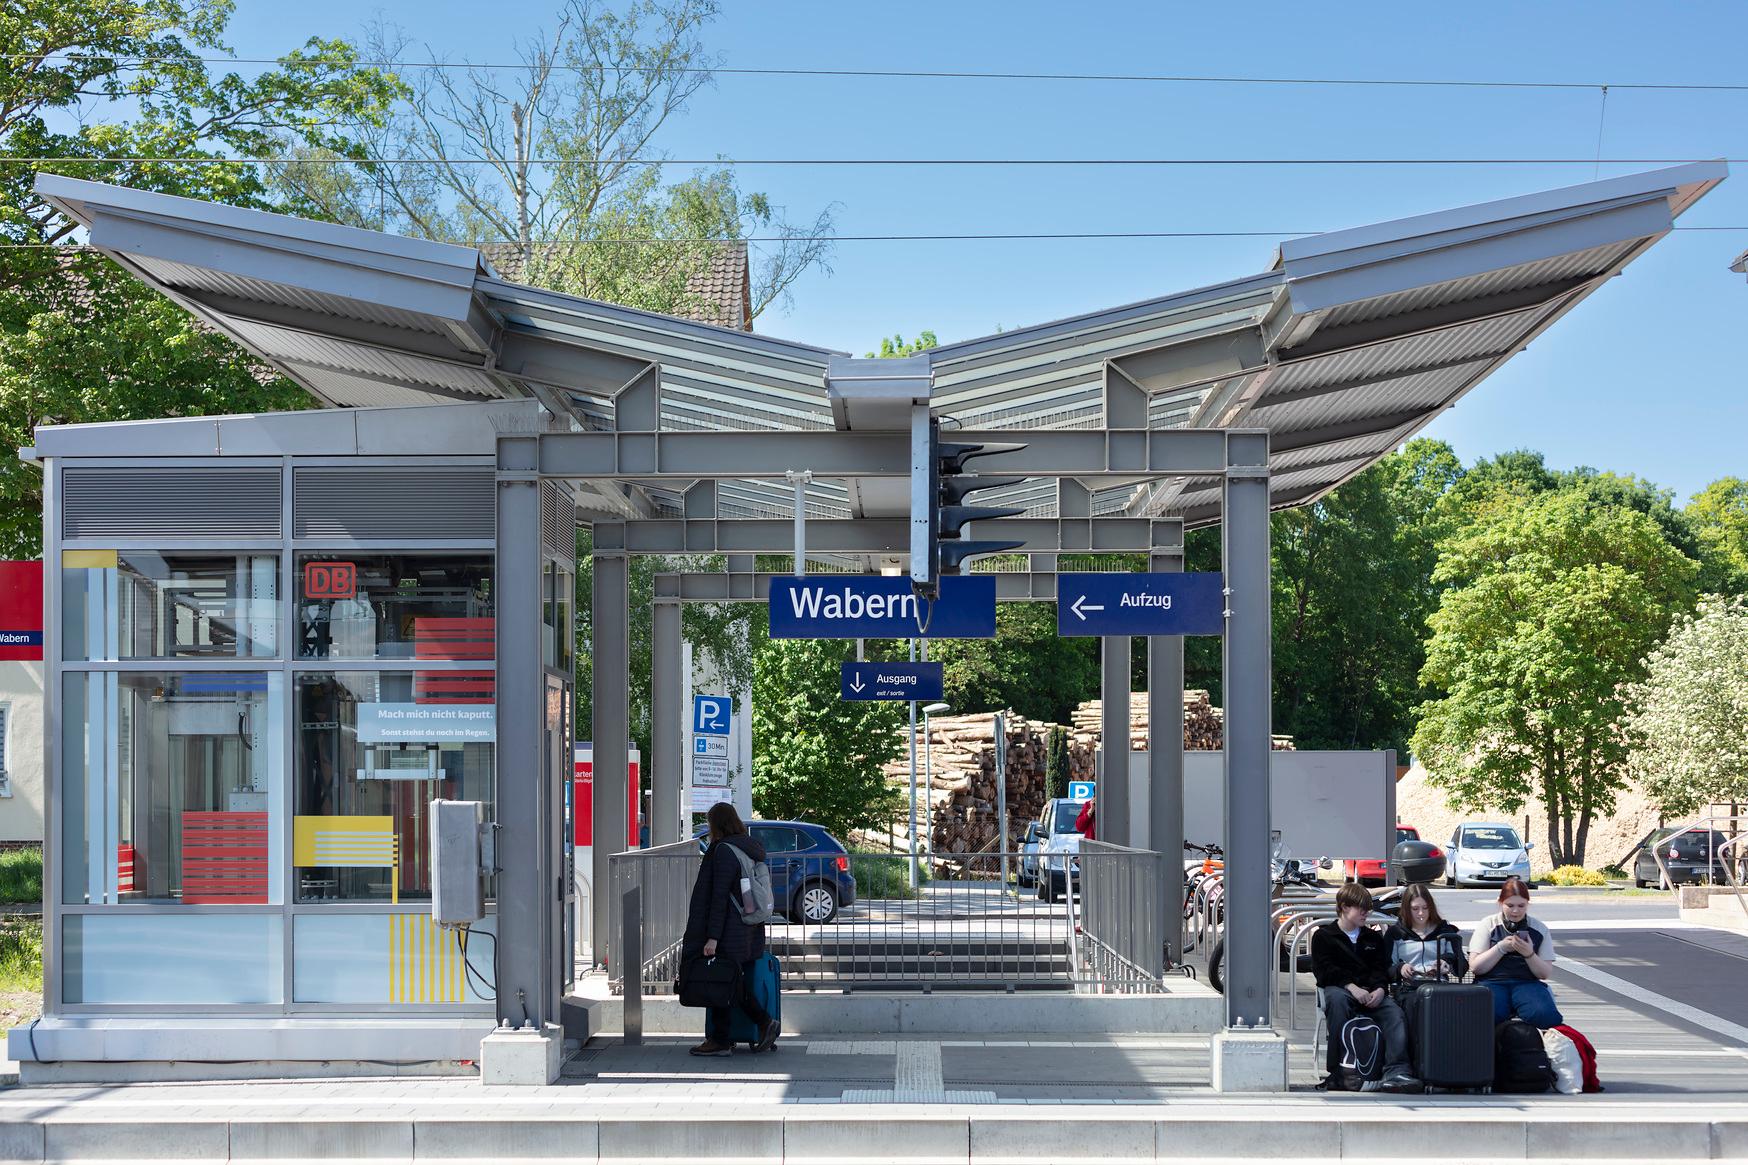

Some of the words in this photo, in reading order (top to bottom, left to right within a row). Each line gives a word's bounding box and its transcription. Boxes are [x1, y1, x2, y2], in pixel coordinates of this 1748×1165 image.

[310, 567, 350, 593] DB
[789, 587, 919, 619] Wabern
[1120, 592, 1172, 609] Aufzug
[876, 673, 917, 685] Ausgang
[378, 710, 405, 719] Mach
[406, 709, 430, 719] mich
[431, 709, 456, 719] nicht
[457, 709, 494, 720] kaputt.
[700, 700, 720, 729] P
[381, 728, 401, 736] Sonst
[401, 728, 424, 736] stehst
[425, 728, 435, 736] du
[436, 728, 454, 736] noch
[454, 728, 464, 736] im
[465, 728, 490, 737] Regen.
[1075, 785, 1090, 799] P
